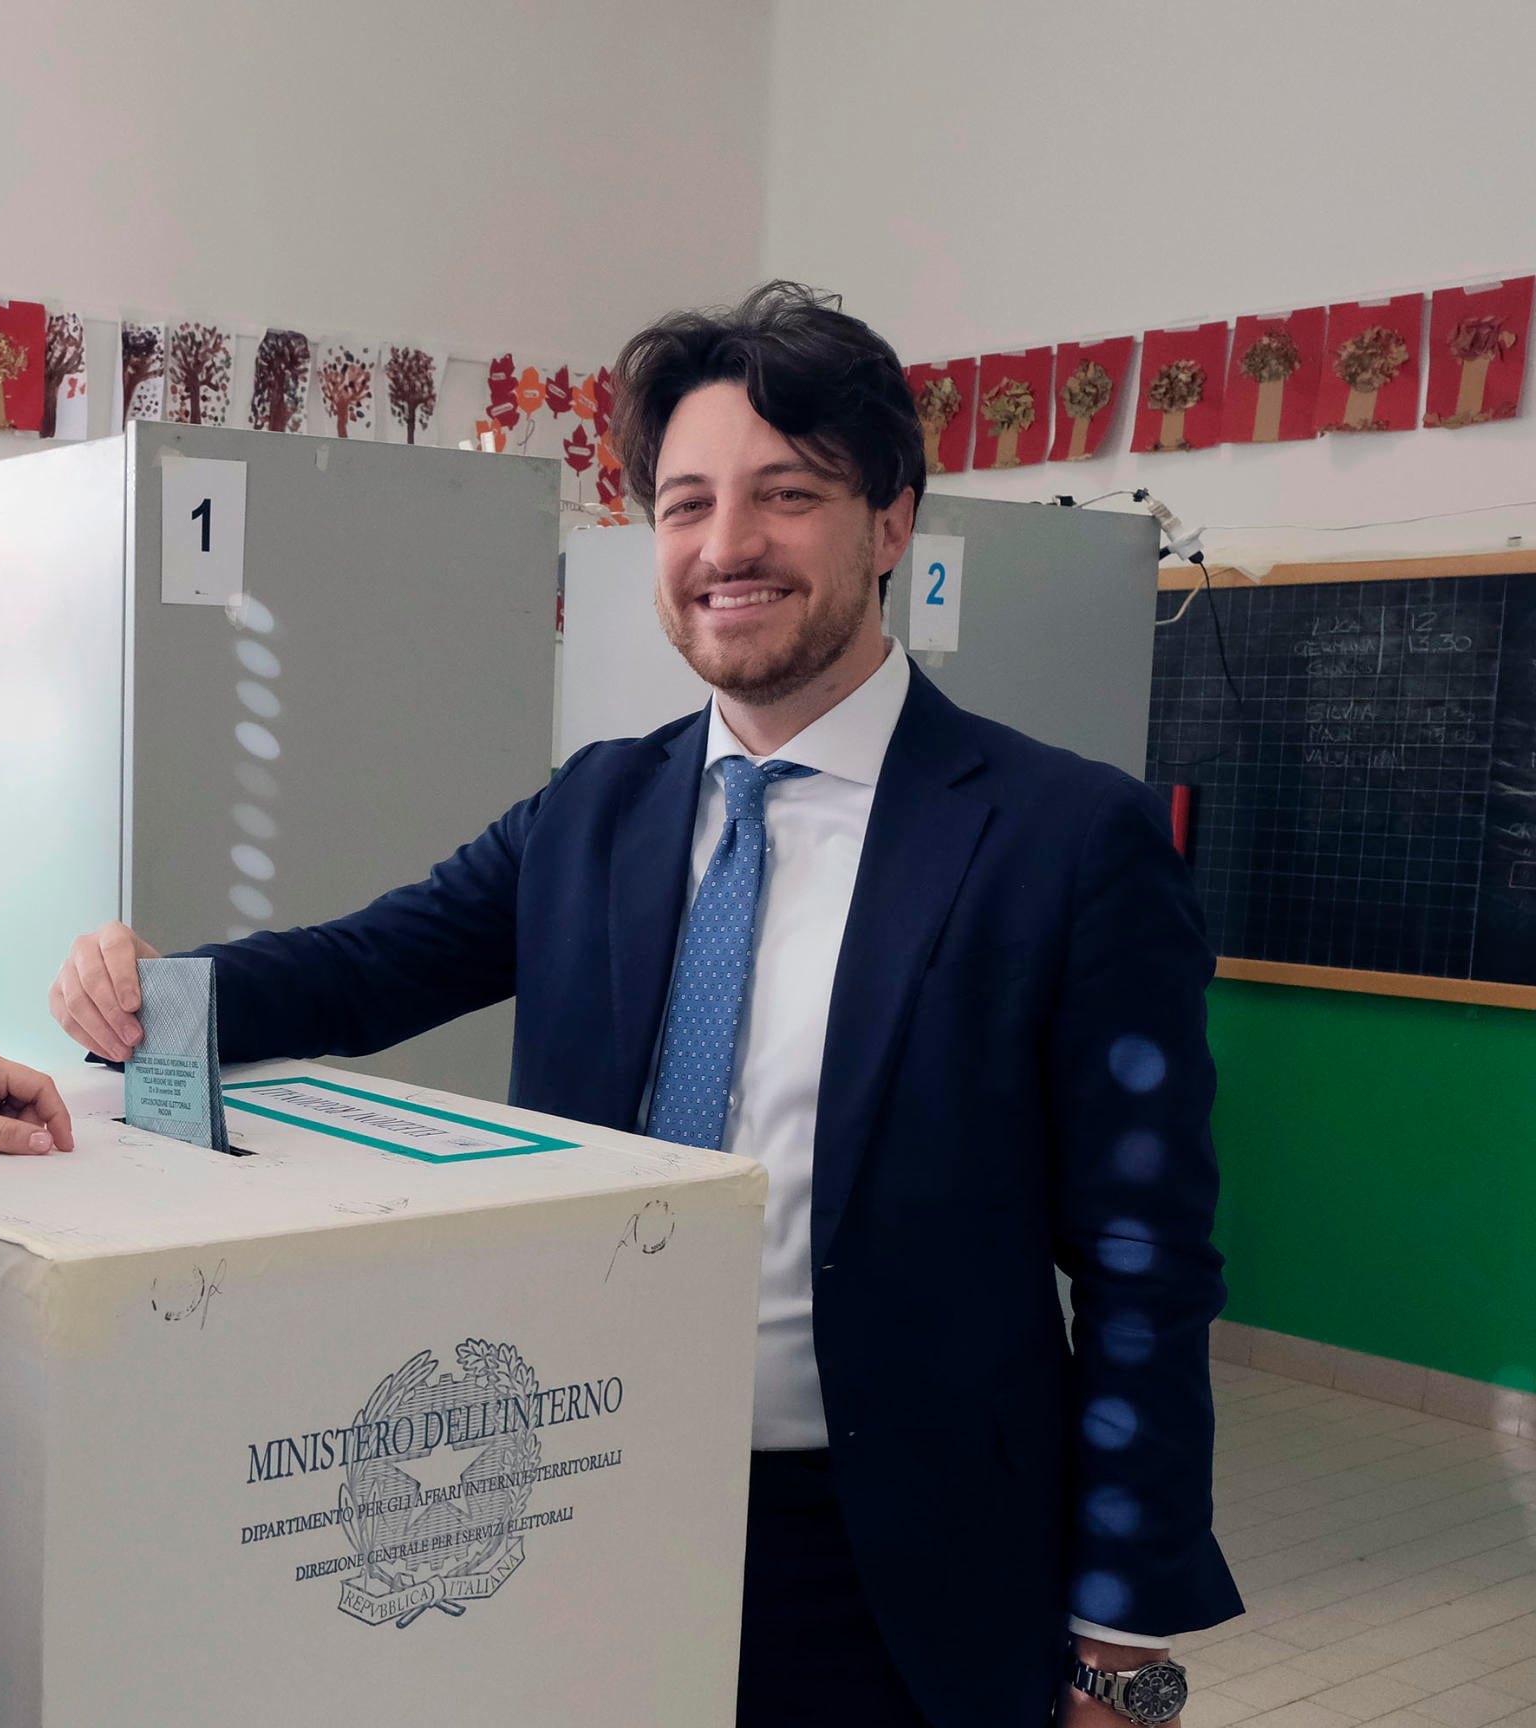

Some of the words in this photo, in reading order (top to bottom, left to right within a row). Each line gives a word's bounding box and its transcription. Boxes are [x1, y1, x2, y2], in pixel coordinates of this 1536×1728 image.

[190, 498, 213, 553] 1
[926, 561, 946, 606] 2
[246, 1416, 414, 1484] MINISTERO
[423, 1376, 625, 1449] DELL'INTERNO
[241, 1507, 353, 1544] DIPARTIMENTO
[357, 1500, 383, 1519] PER
[387, 1494, 411, 1512] GLI
[414, 1482, 464, 1508] AFFARI
[464, 1471, 520, 1496] INTERNI
[535, 1449, 623, 1482] TERRITORIALI
[295, 1553, 364, 1581] DIREZIONE
[367, 1540, 429, 1564] CENTRALE
[431, 1535, 453, 1550] PER
[461, 1522, 504, 1543] SERVIZI
[507, 1506, 574, 1533] ELETTORALI
[450, 1554, 520, 1596] ITALIANA
